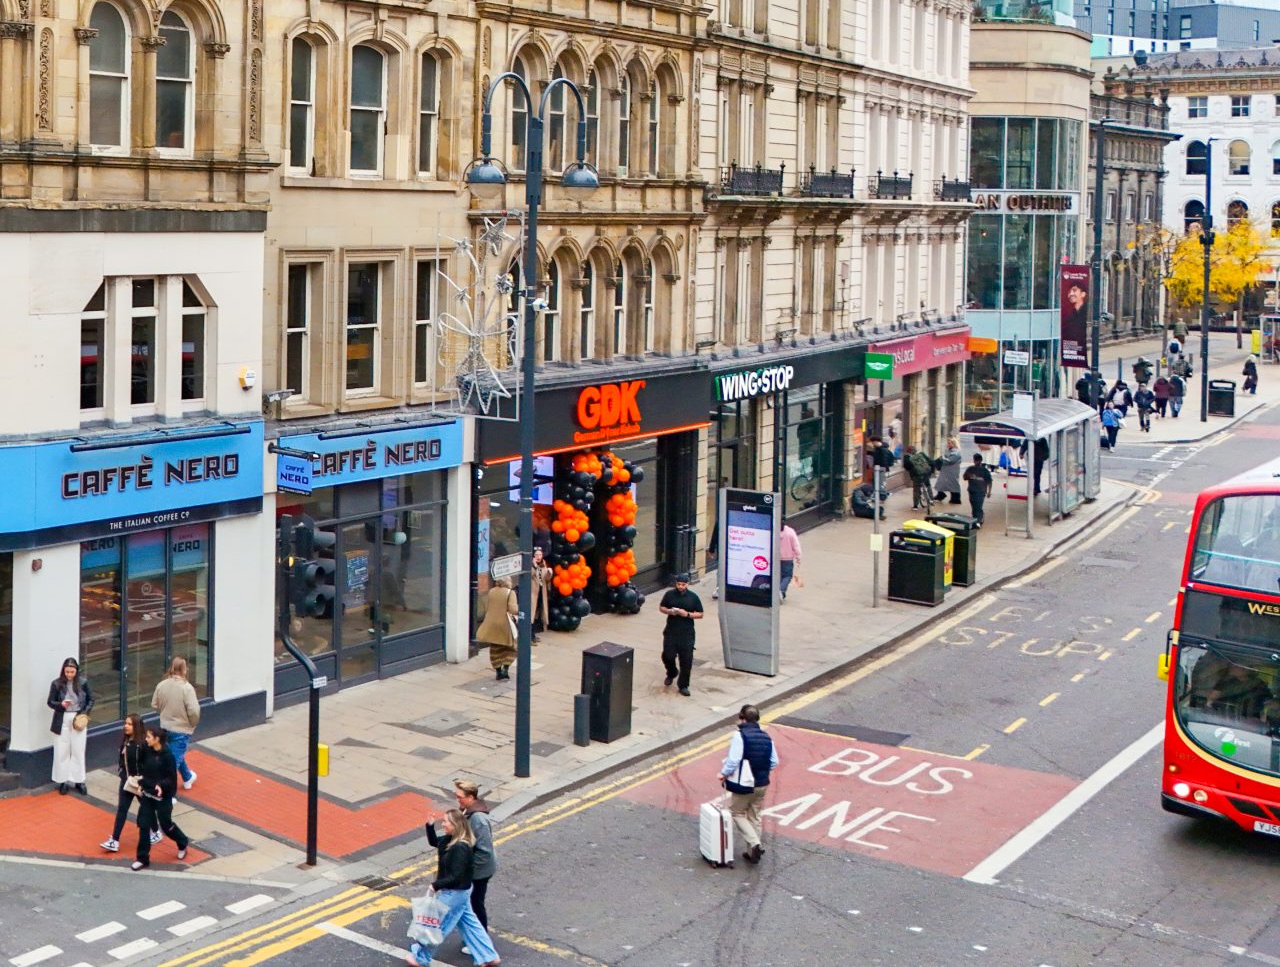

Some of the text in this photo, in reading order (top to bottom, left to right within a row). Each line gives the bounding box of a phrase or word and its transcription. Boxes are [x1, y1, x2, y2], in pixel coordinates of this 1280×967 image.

[578, 380, 642, 430] GDK
[385, 438, 442, 467] NERO
[164, 453, 239, 486] NERO
[280, 472, 309, 485] NERO
[110, 521, 122, 530] THE
[125, 517, 151, 528] ITALIAN
[153, 513, 178, 523] COFFEE
[989, 605, 1113, 634] BS
[807, 747, 973, 795] BUS
[760, 792, 937, 850] ANE
